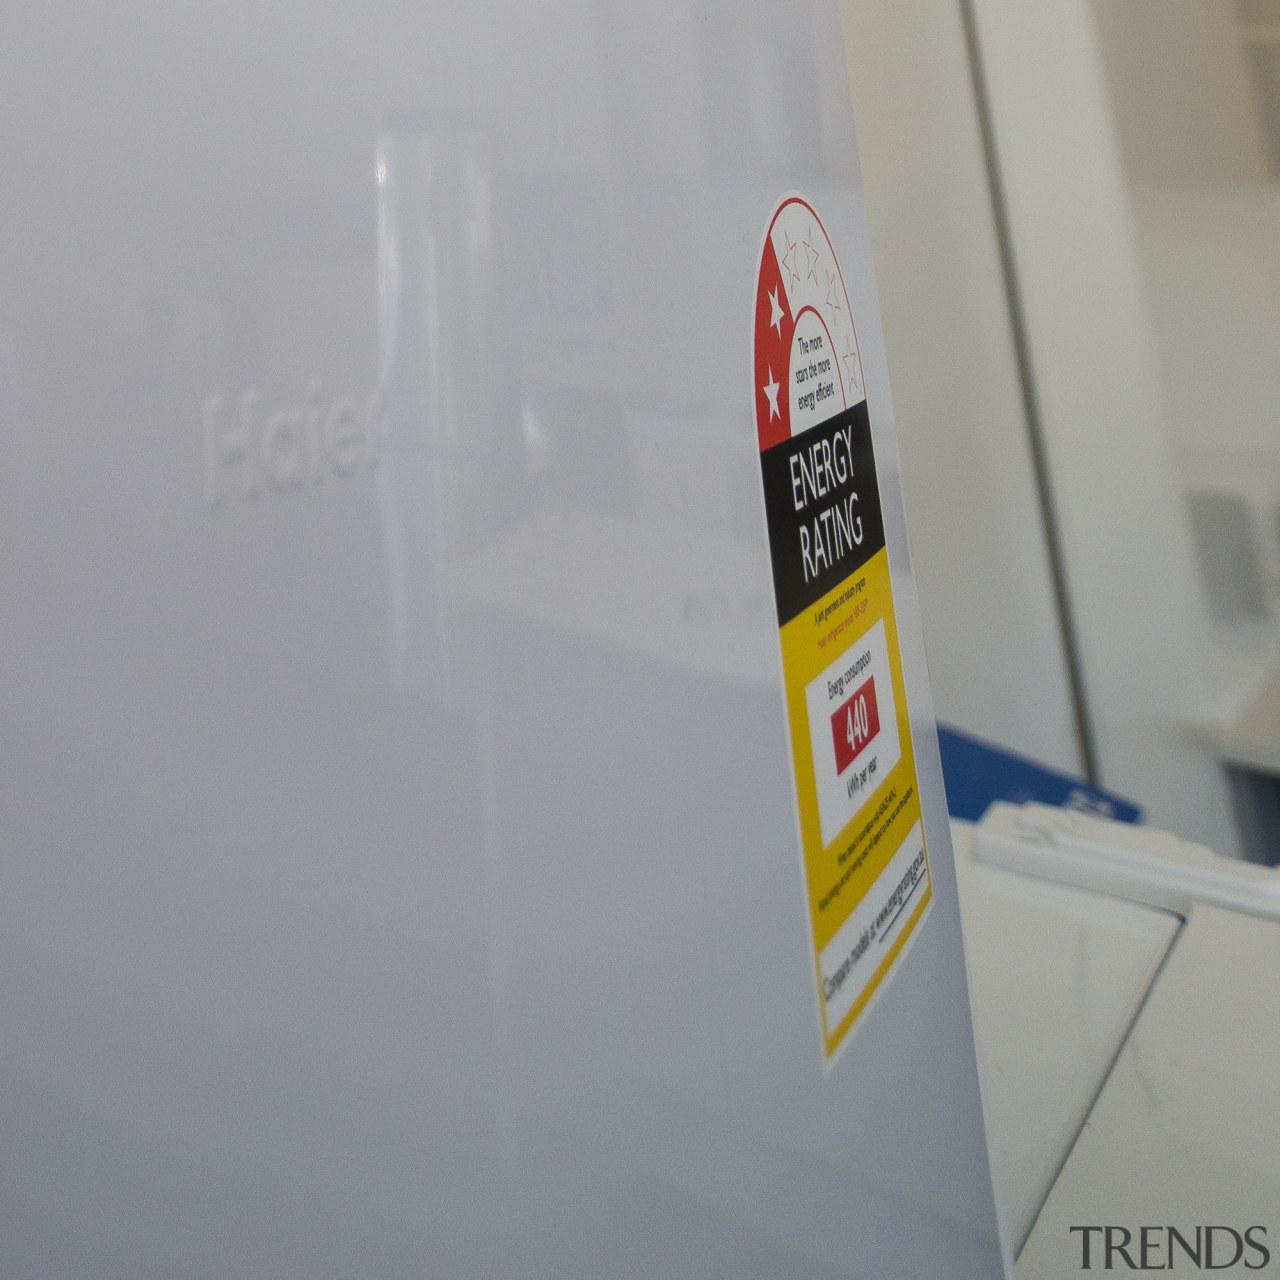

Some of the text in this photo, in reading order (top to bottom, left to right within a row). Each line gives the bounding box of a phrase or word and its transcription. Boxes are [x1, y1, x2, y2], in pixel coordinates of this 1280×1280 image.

[797, 336, 823, 355] The more
[795, 358, 831, 385] stars the more
[798, 382, 835, 411] energy efficient
[788, 424, 856, 512] ENERGY
[799, 491, 864, 584] RATING
[827, 649, 872, 701] Energy consumption
[846, 693, 869, 752] 440
[846, 755, 878, 800] kWh per year
